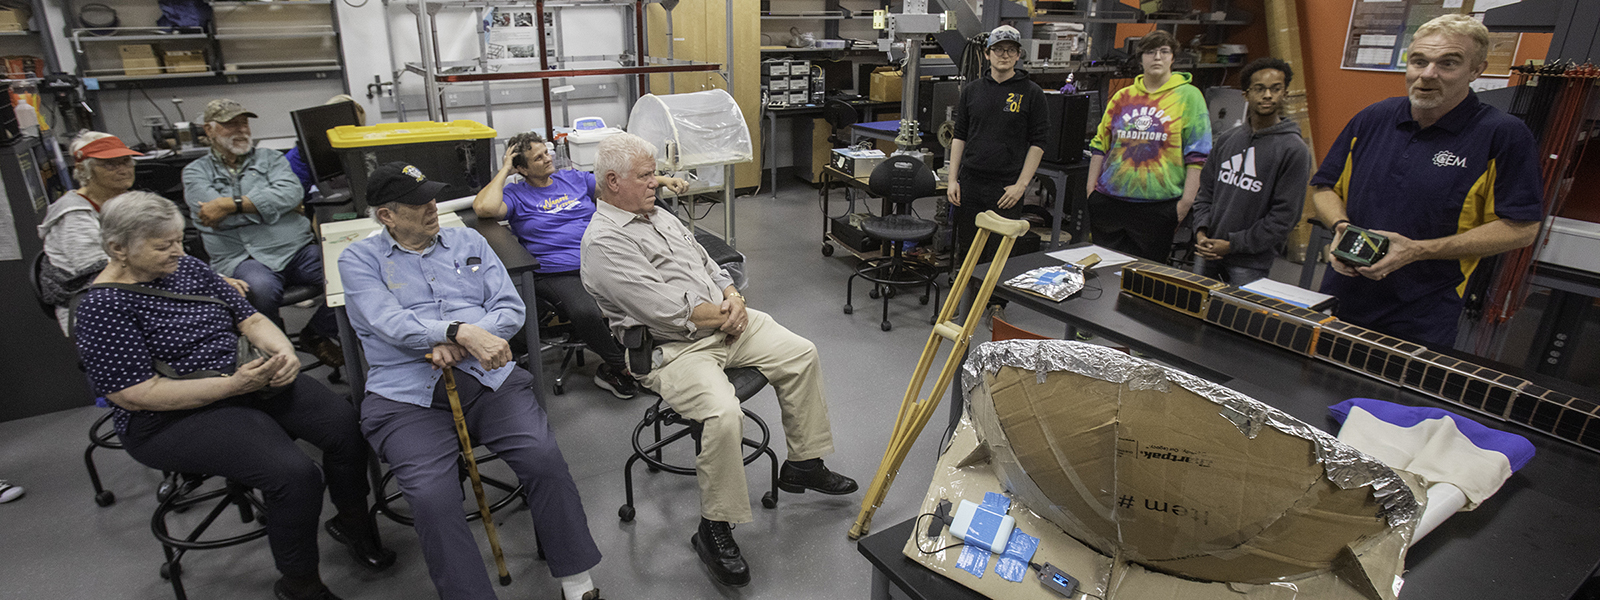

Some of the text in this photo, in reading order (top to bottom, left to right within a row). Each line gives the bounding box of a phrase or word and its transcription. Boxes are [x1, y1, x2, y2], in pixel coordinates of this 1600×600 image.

[1122, 106, 1172, 125] NANOOK
[1117, 129, 1168, 141] TRADITIONS
[1118, 494, 1135, 509] #
